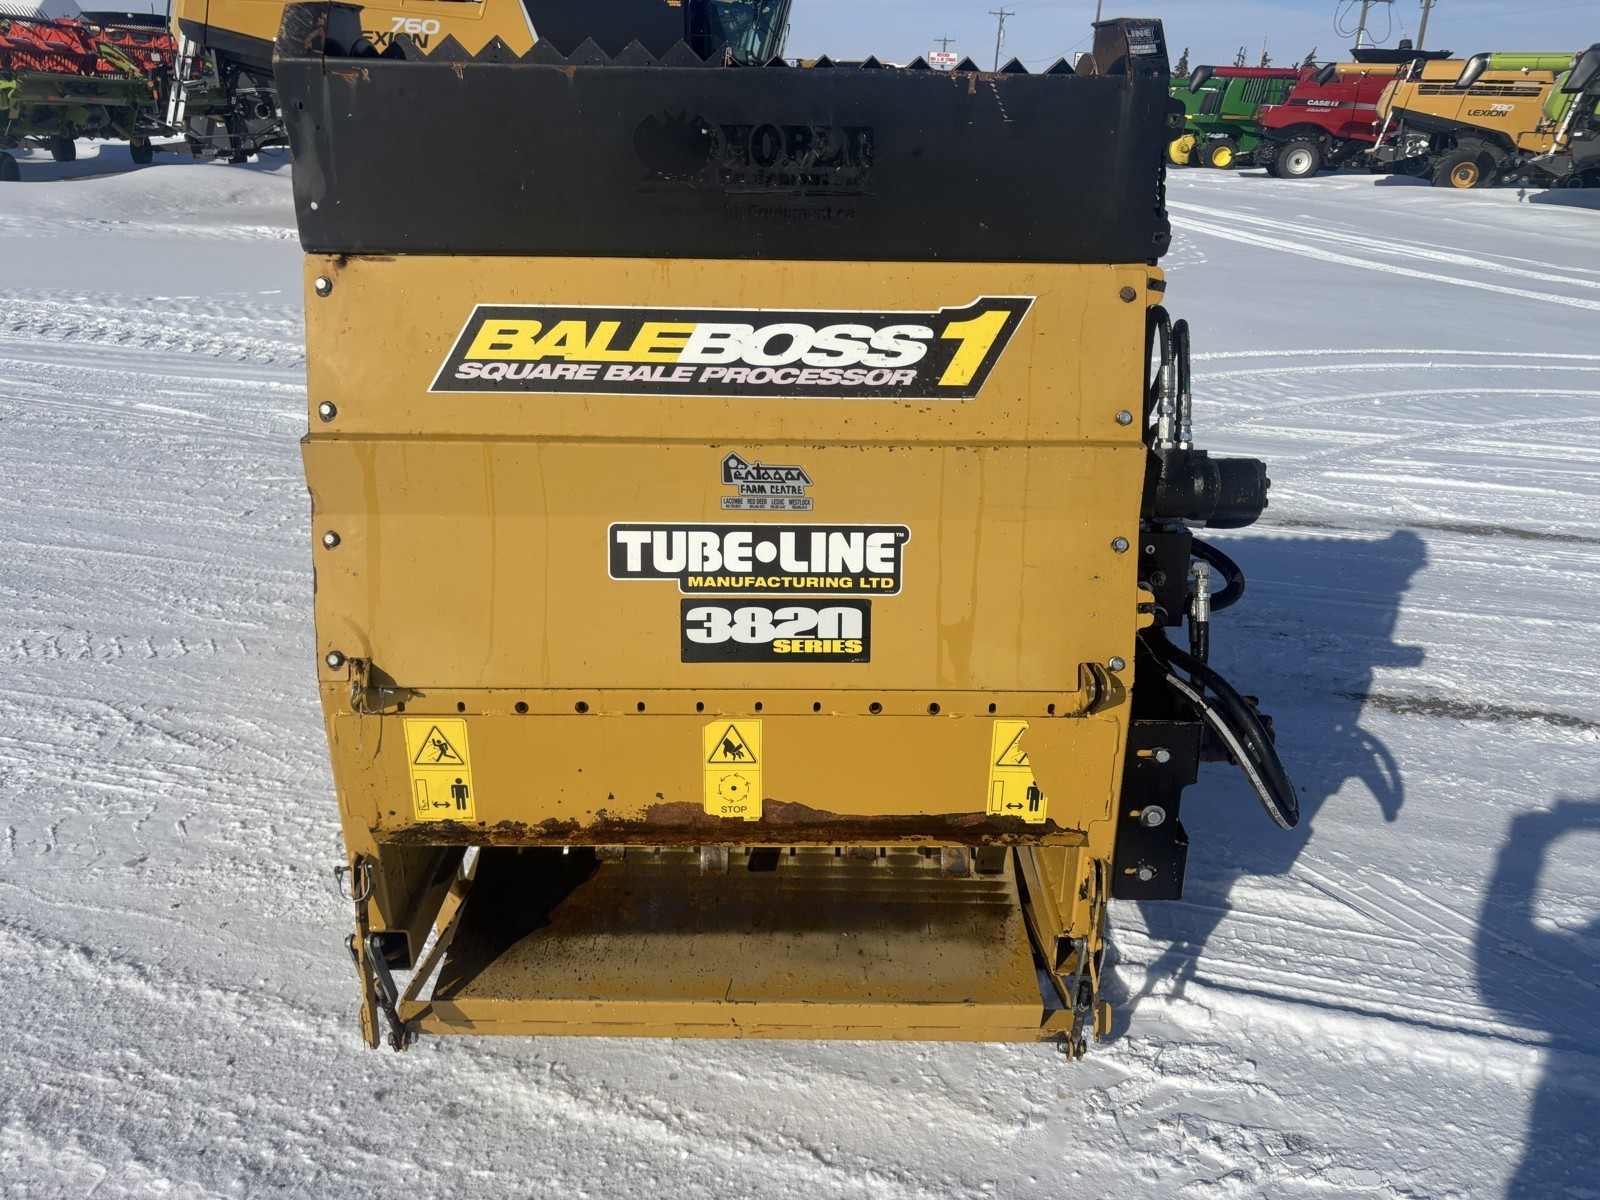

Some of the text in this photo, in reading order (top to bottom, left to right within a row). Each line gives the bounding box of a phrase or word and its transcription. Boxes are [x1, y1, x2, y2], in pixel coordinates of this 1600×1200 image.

[391, 17, 440, 34] 760
[361, 30, 429, 48] EXIN
[1467, 109, 1508, 117] LEXION
[938, 310, 1012, 386] 1
[454, 362, 918, 386] SQUARE BALE PROCESSOR
[723, 453, 811, 484] Pentagon
[740, 484, 803, 495] FARM CENTRE
[688, 576, 894, 589] MANUFACTURING LTD
[772, 639, 863, 653] SERIES
[721, 805, 747, 813] STOP
